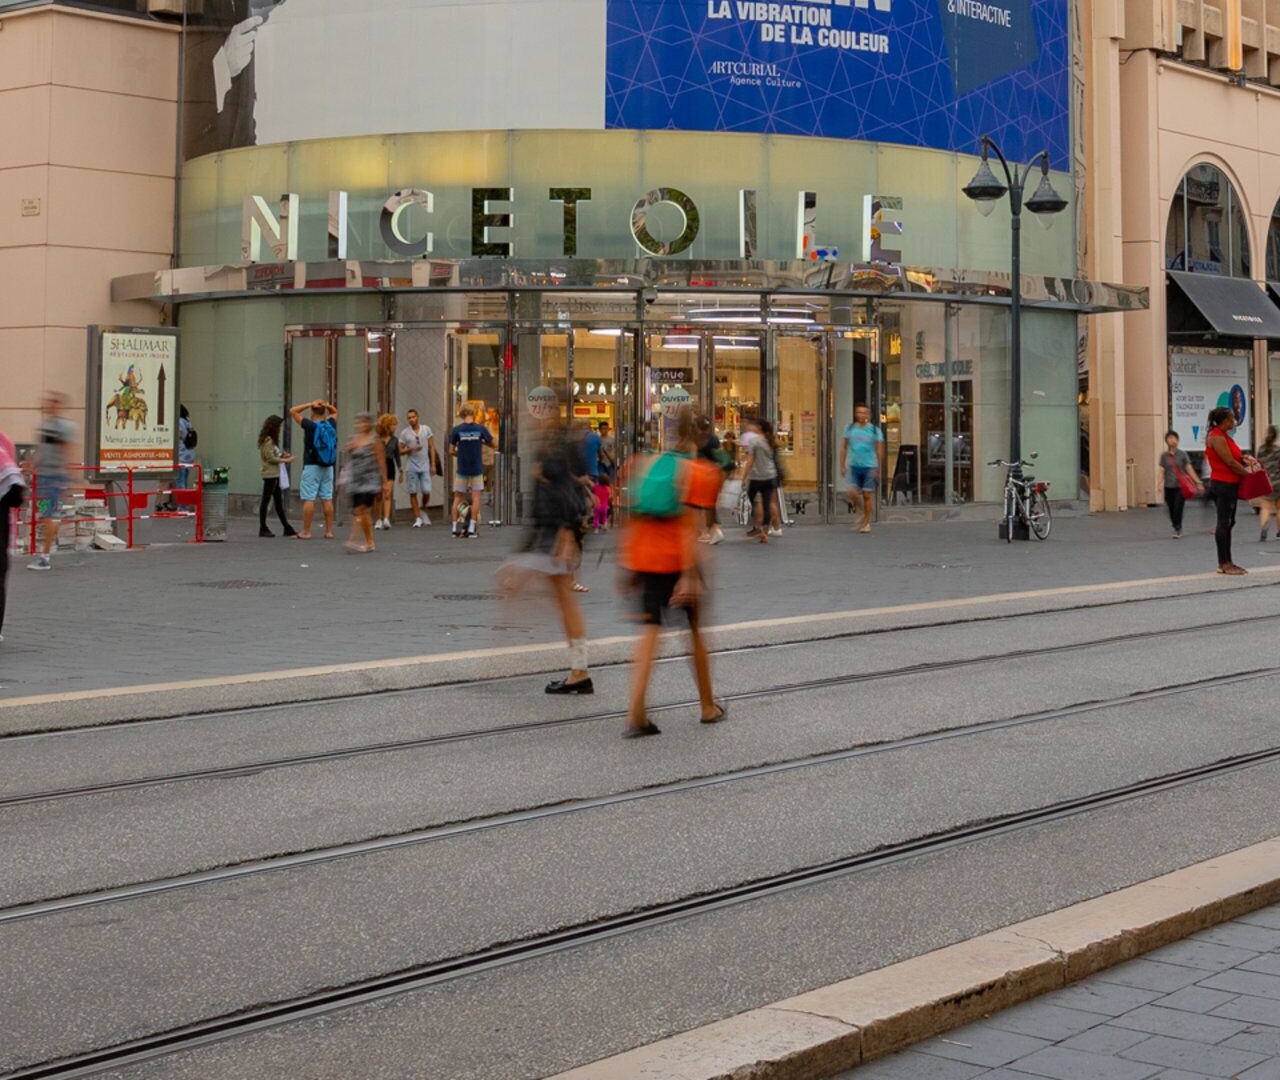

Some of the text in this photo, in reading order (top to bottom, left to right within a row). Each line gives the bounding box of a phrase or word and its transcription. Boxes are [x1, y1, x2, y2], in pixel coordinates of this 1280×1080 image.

[707, 0, 832, 27] LA VIBRATION
[761, 23, 889, 54] DE LA COULEUR
[707, 61, 780, 77] ARTCURIAL
[730, 75, 801, 88] Agence Culture
[241, 187, 904, 263] NICETOILE
[110, 338, 169, 352] SHALIMAR
